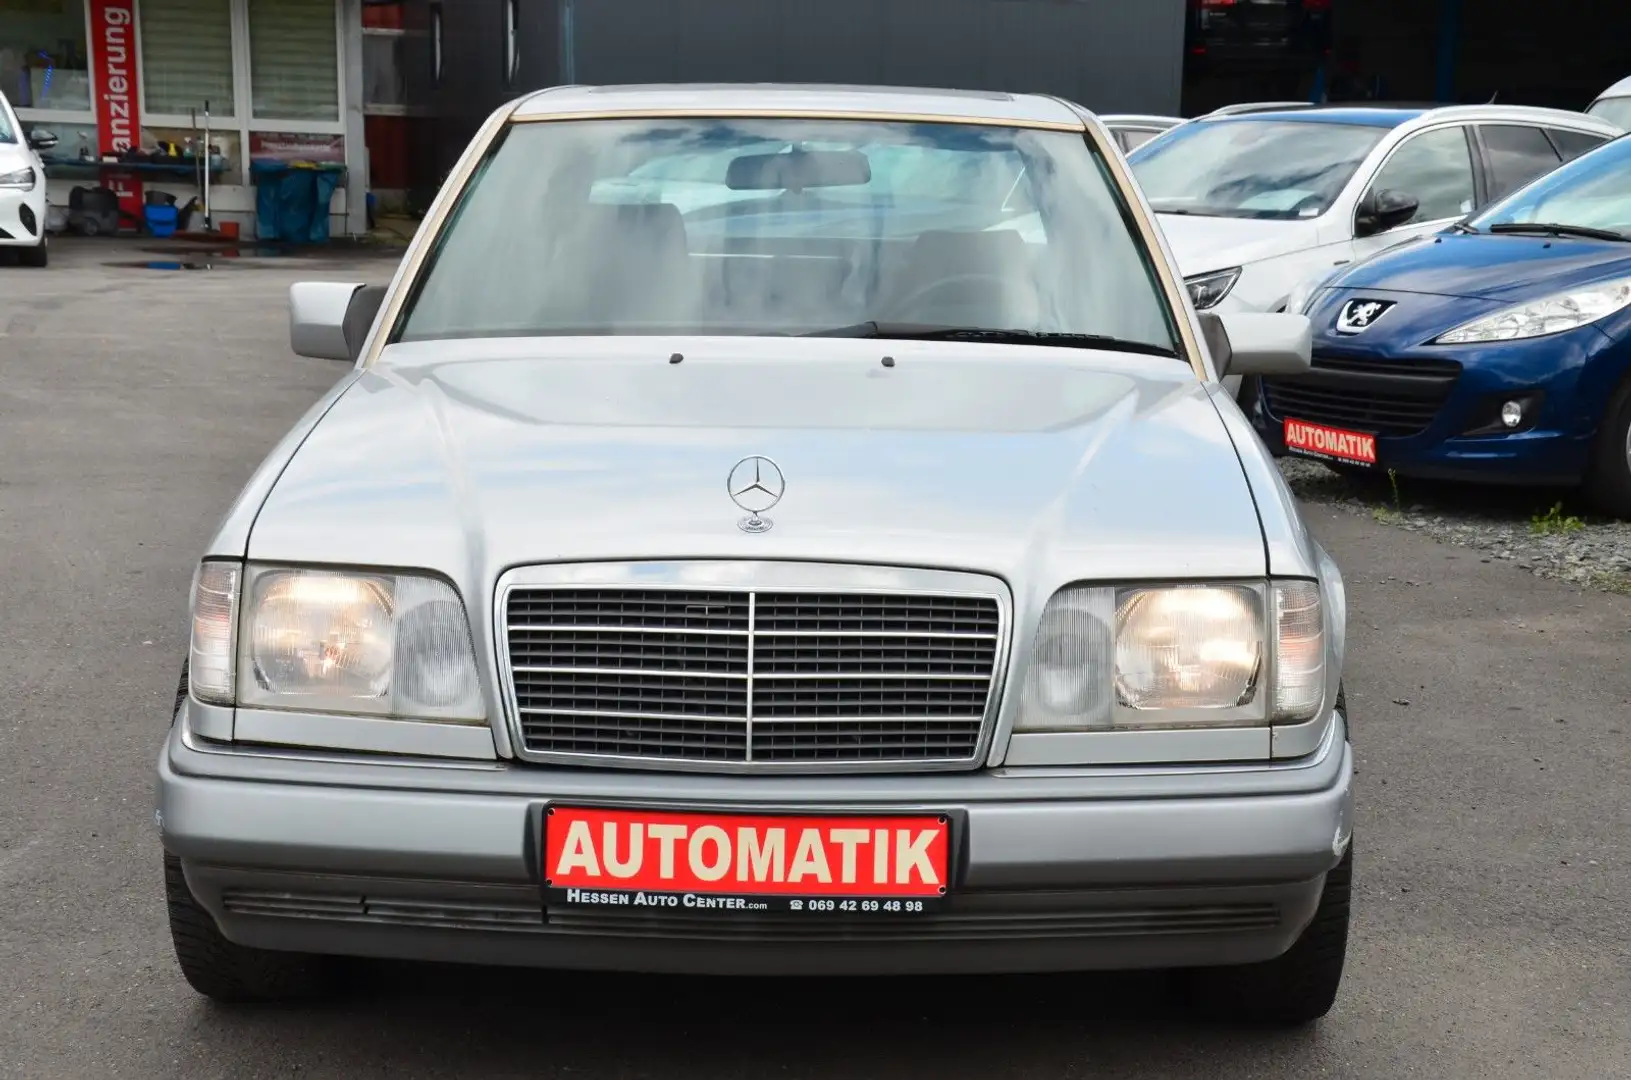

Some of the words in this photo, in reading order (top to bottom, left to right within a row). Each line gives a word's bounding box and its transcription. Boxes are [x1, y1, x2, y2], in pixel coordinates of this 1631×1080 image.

[1286, 423, 1376, 461] AUTOMATIK
[556, 820, 940, 885] AUTOMATIK
[808, 900, 835, 911] 069
[839, 900, 857, 911] 42
[861, 900, 879, 911] 69
[883, 900, 901, 911] 48
[905, 901, 923, 912] 98
